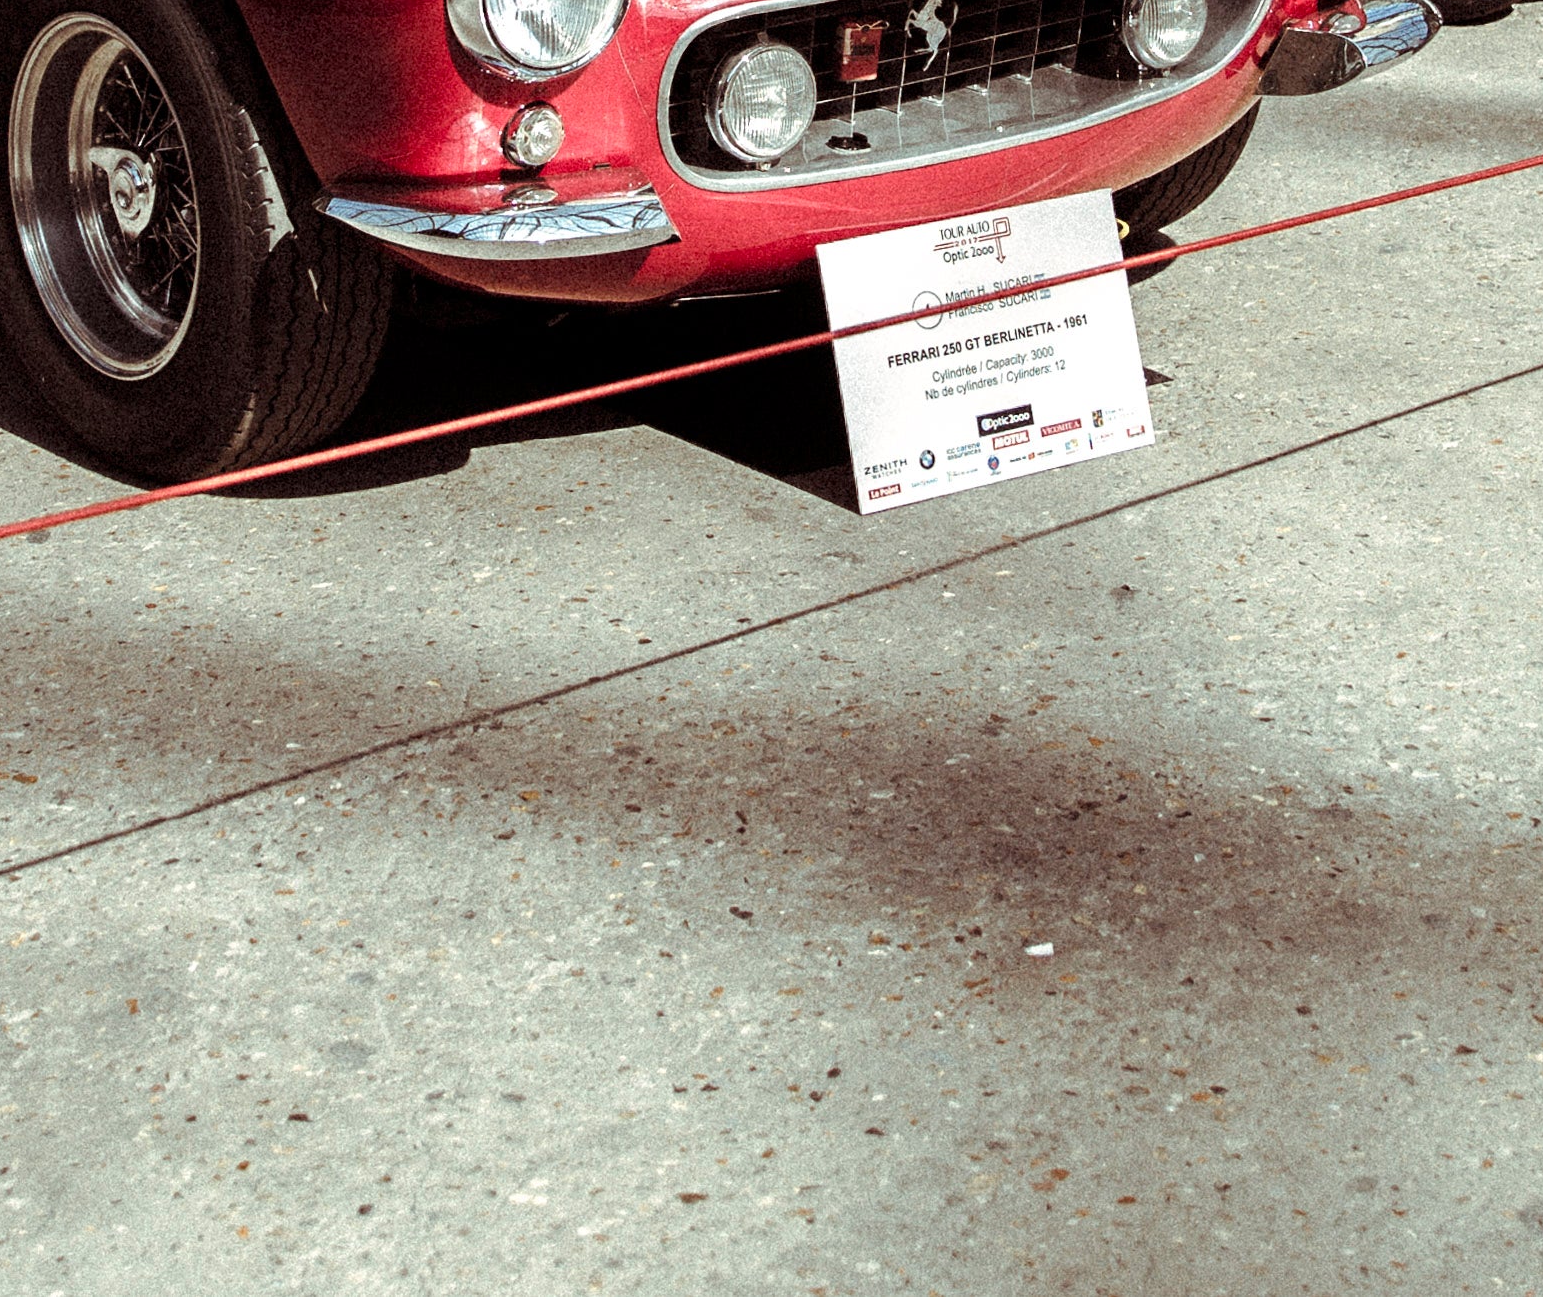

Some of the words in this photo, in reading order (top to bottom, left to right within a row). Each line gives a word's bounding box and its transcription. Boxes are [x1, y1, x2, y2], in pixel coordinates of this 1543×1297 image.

[940, 225, 964, 240] TOUR
[966, 220, 990, 236] AUTO
[955, 237, 978, 247] 2017
[943, 247, 969, 264] Optic
[971, 245, 995, 258] 2000
[945, 287, 975, 303] Martin
[993, 274, 1033, 293] SUCARI
[999, 289, 1038, 309] SUCARI
[887, 346, 940, 369] FERRARI
[942, 341, 962, 357] 250
[965, 337, 981, 351] GT
[983, 321, 1055, 347] BERLINETTA
[1063, 314, 1088, 330] 1961
[932, 363, 978, 384] Cylindrée
[1031, 345, 1055, 361] 3000
[925, 388, 940, 401] Nb
[942, 385, 954, 398] de
[956, 375, 999, 395] cylindres
[1006, 364, 1052, 384] Cylinders:
[1055, 359, 1066, 371] 12
[994, 431, 1029, 448] MOTUL
[864, 458, 908, 475] ZENITH
[871, 468, 902, 480] WATCHES
